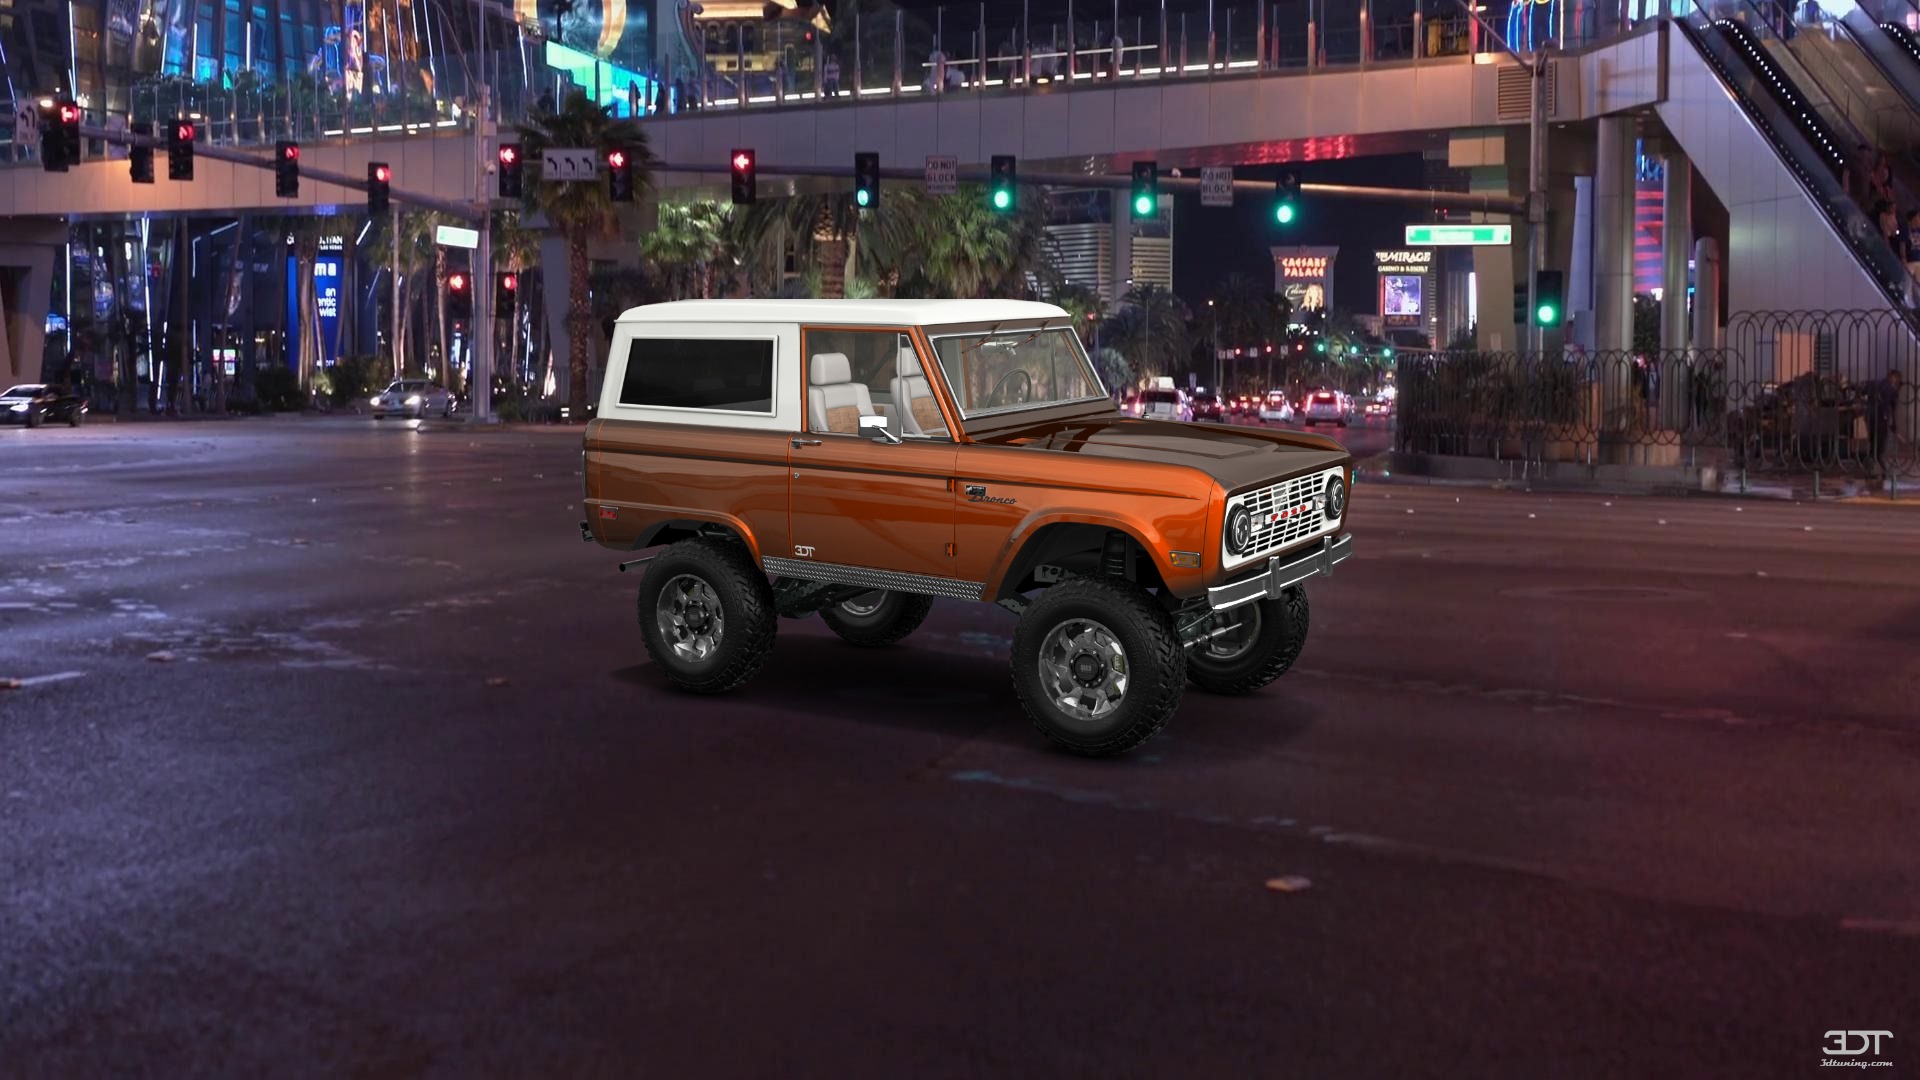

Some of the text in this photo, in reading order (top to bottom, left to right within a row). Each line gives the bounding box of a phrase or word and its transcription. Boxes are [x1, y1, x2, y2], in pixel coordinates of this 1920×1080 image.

[1281, 257, 1327, 268] CAESARS
[1387, 251, 1431, 263] MIRAGE
[1284, 267, 1325, 277] PALACE
[968, 494, 1018, 505] Bronco
